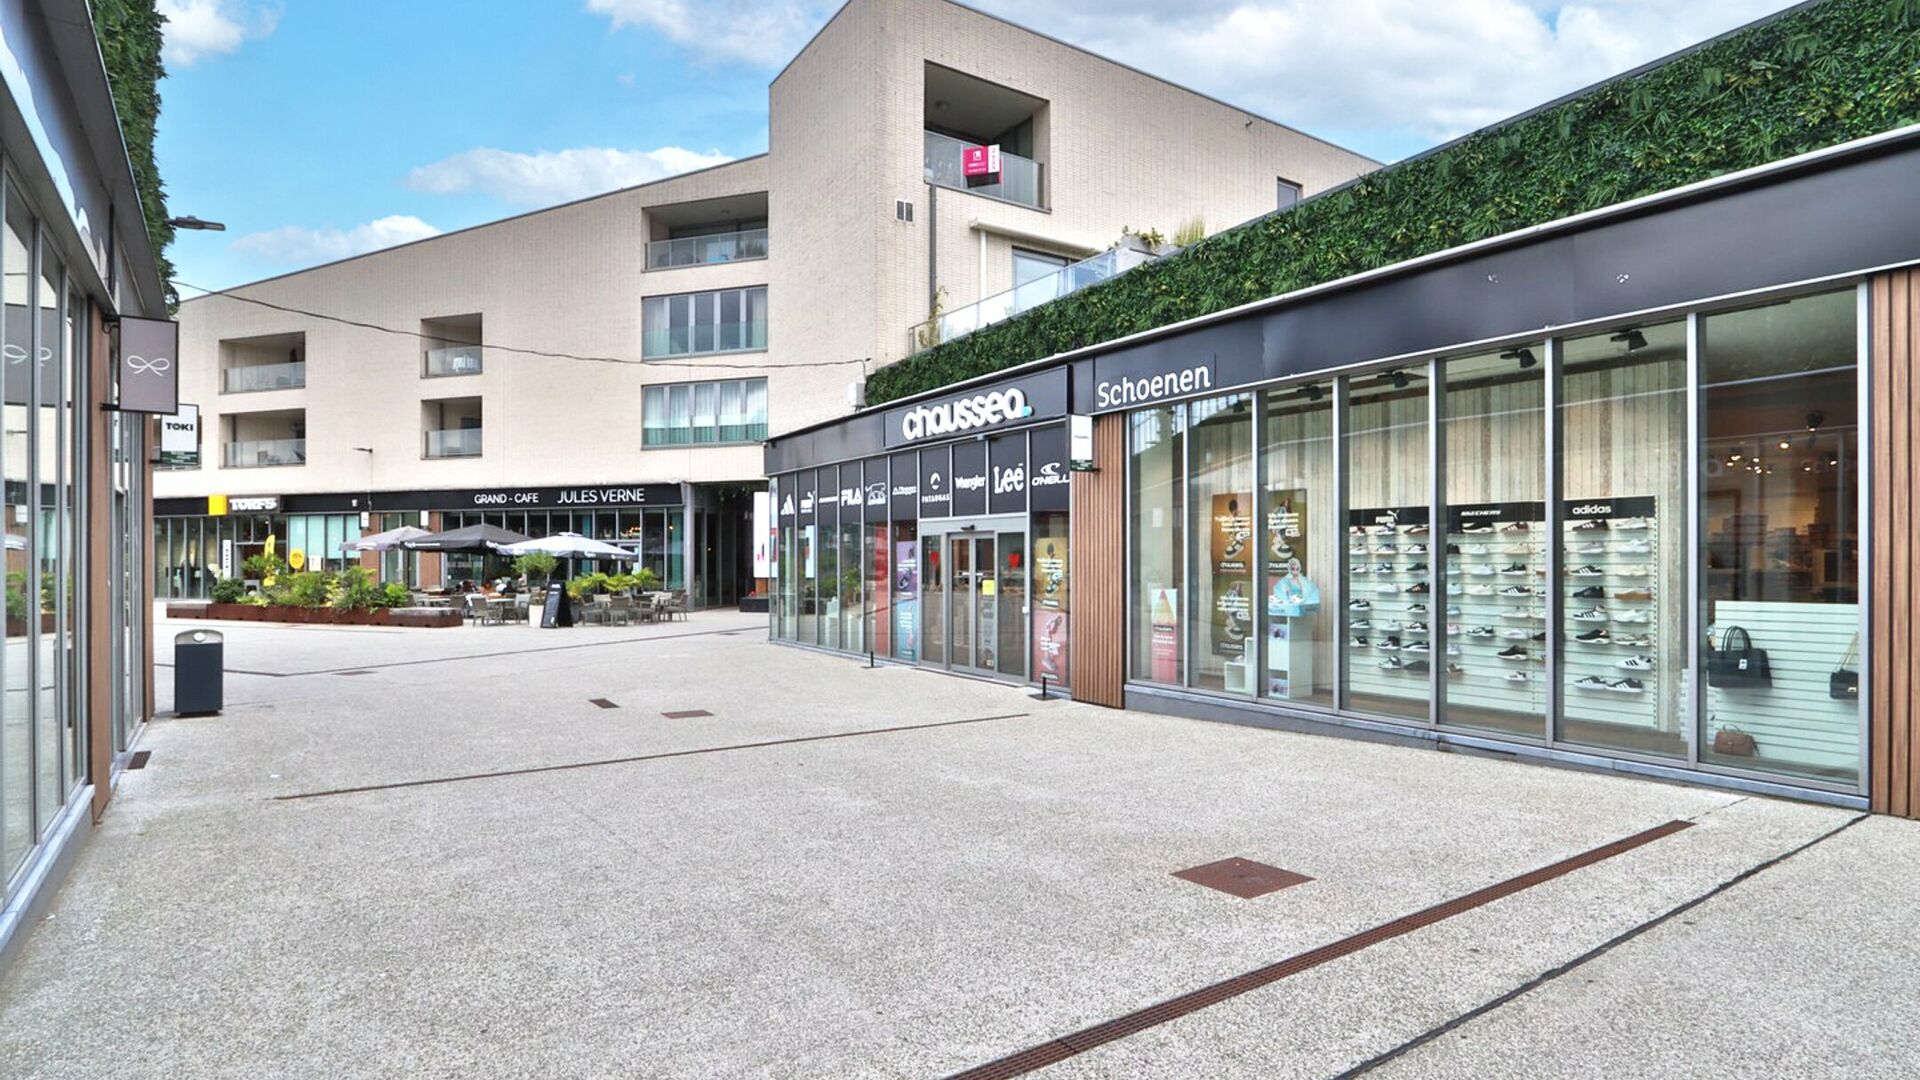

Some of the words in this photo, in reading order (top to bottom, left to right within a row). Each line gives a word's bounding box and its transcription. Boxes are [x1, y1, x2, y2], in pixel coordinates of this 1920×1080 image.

[1097, 365, 1211, 408] Schoenen
[166, 422, 194, 431] TOKI
[955, 474, 985, 491] Wrangler
[993, 464, 1024, 494] Lee
[229, 498, 277, 510] TORFS
[474, 494, 507, 504] GRAND
[514, 492, 539, 504] CAFE
[557, 489, 598, 504] JULES
[600, 488, 645, 502] VERNE
[841, 487, 862, 507] FILA
[1573, 503, 1612, 514] adidas
